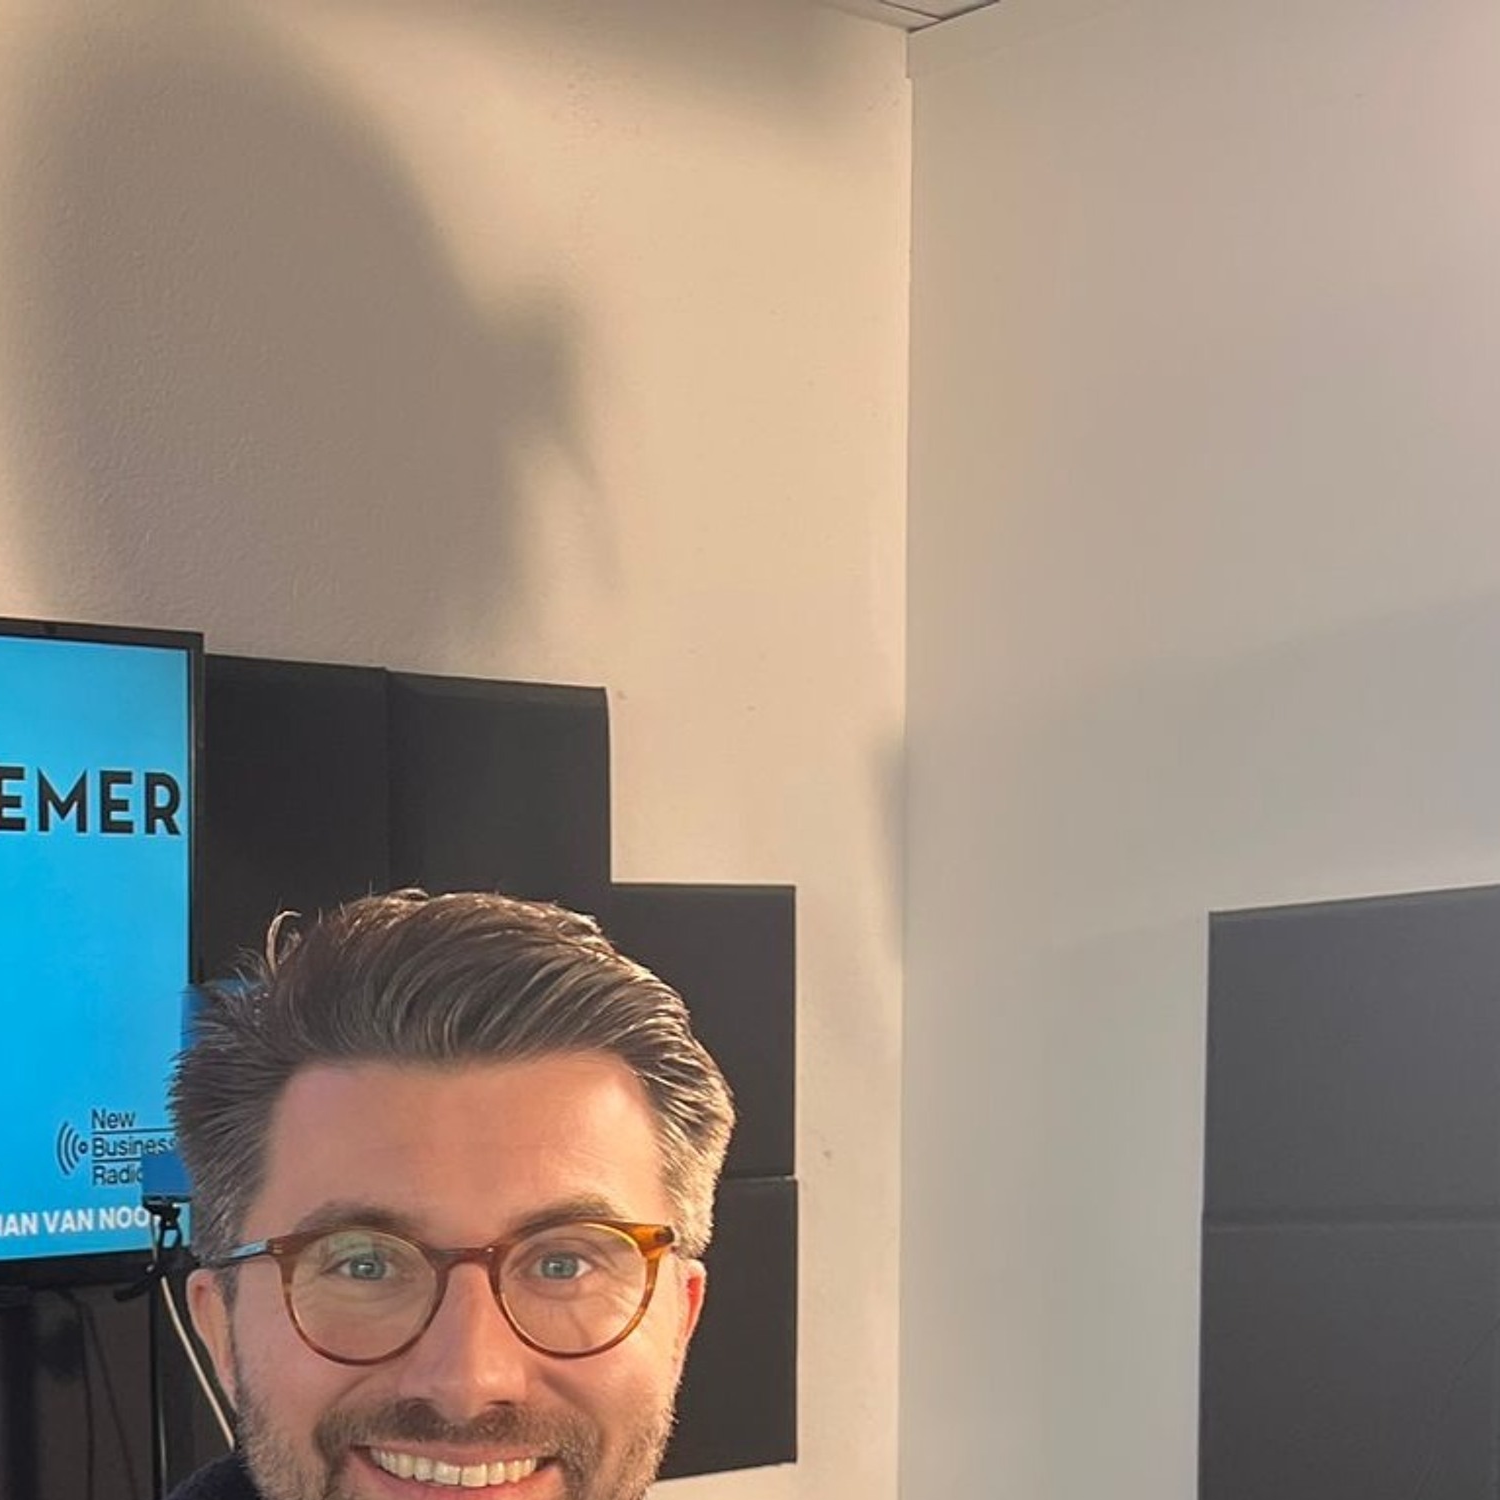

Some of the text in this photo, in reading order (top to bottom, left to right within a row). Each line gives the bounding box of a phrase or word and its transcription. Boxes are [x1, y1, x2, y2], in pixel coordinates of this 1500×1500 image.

[92, 1109, 136, 1129] New
[42, 1207, 94, 1234] VAN
[100, 1205, 151, 1230] NOO
